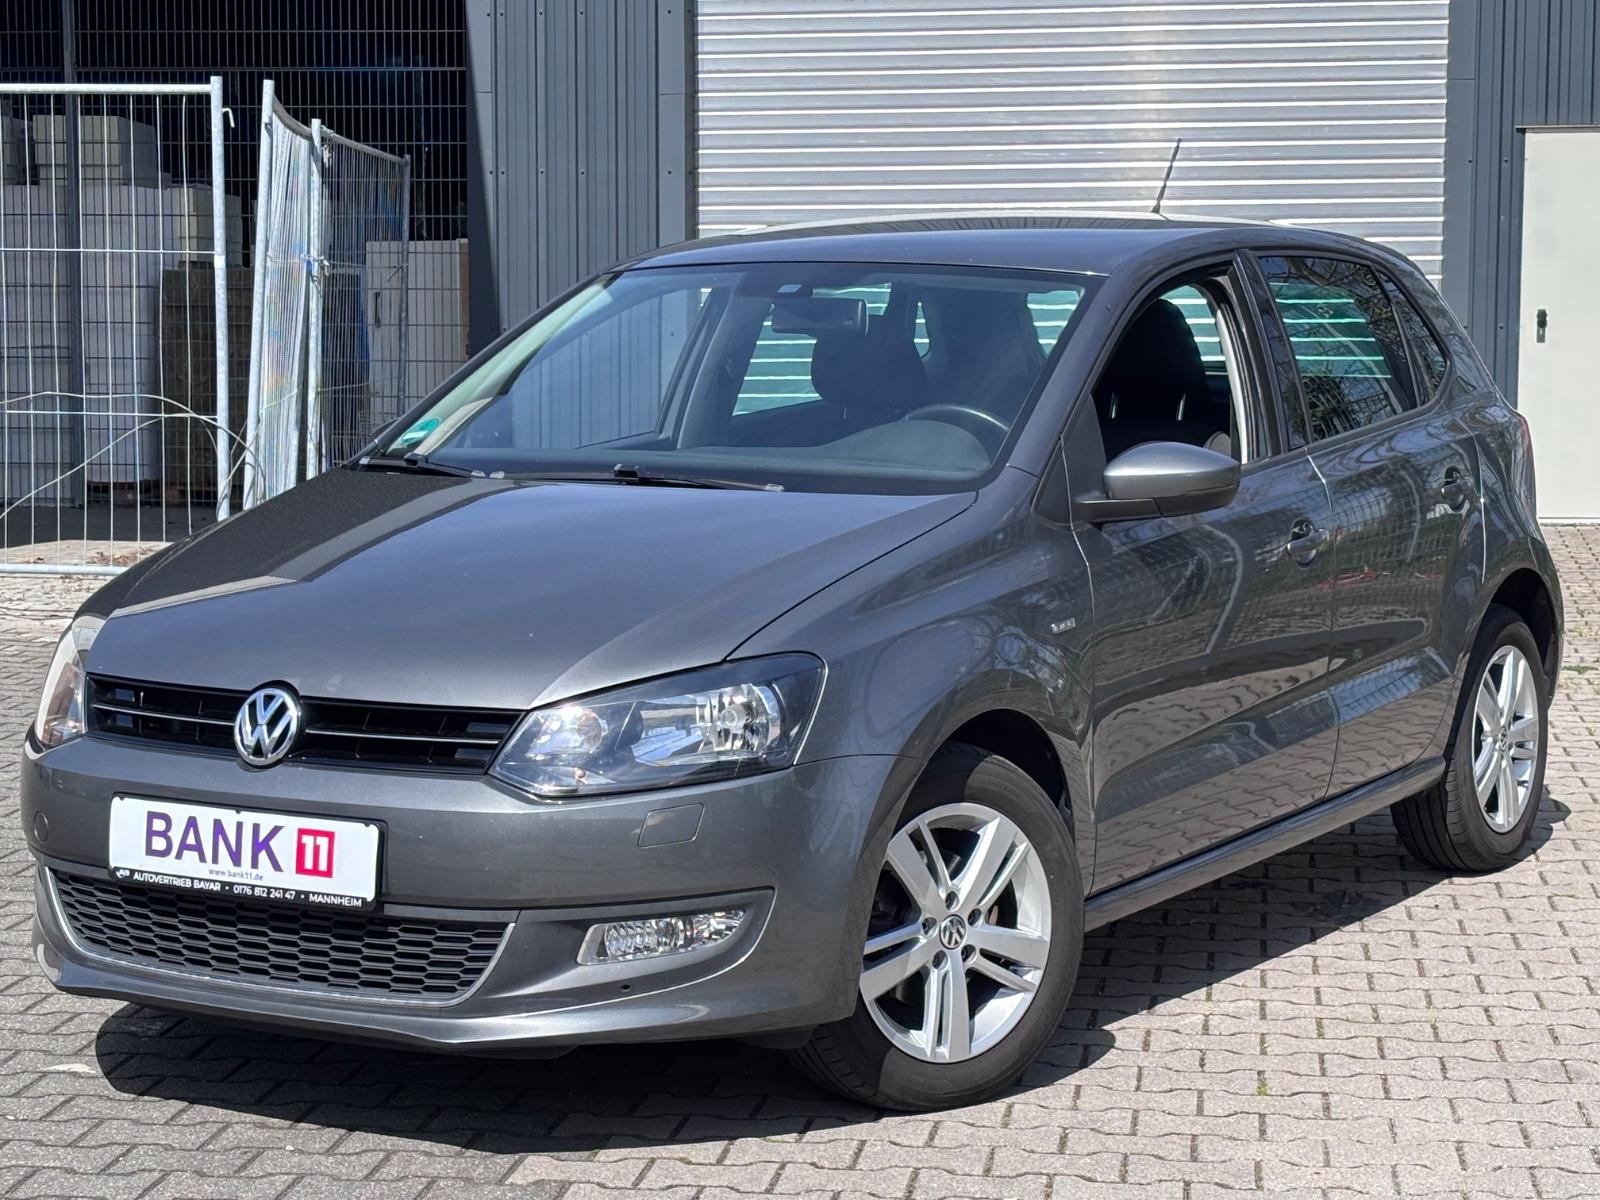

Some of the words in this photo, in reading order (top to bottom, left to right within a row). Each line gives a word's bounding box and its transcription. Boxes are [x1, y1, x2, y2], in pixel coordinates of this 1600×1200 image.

[145, 810, 285, 873] BANK
[300, 834, 329, 873] 11
[133, 871, 192, 888] AUTOVERTRIEB
[193, 879, 221, 891] BAYAR
[233, 884, 252, 896] 0176
[253, 887, 268, 898] 812
[269, 889, 283, 899] 241
[284, 891, 296, 900] 47
[309, 893, 362, 907] MANNHEIM
[208, 869, 264, 881] www.bank11.de
